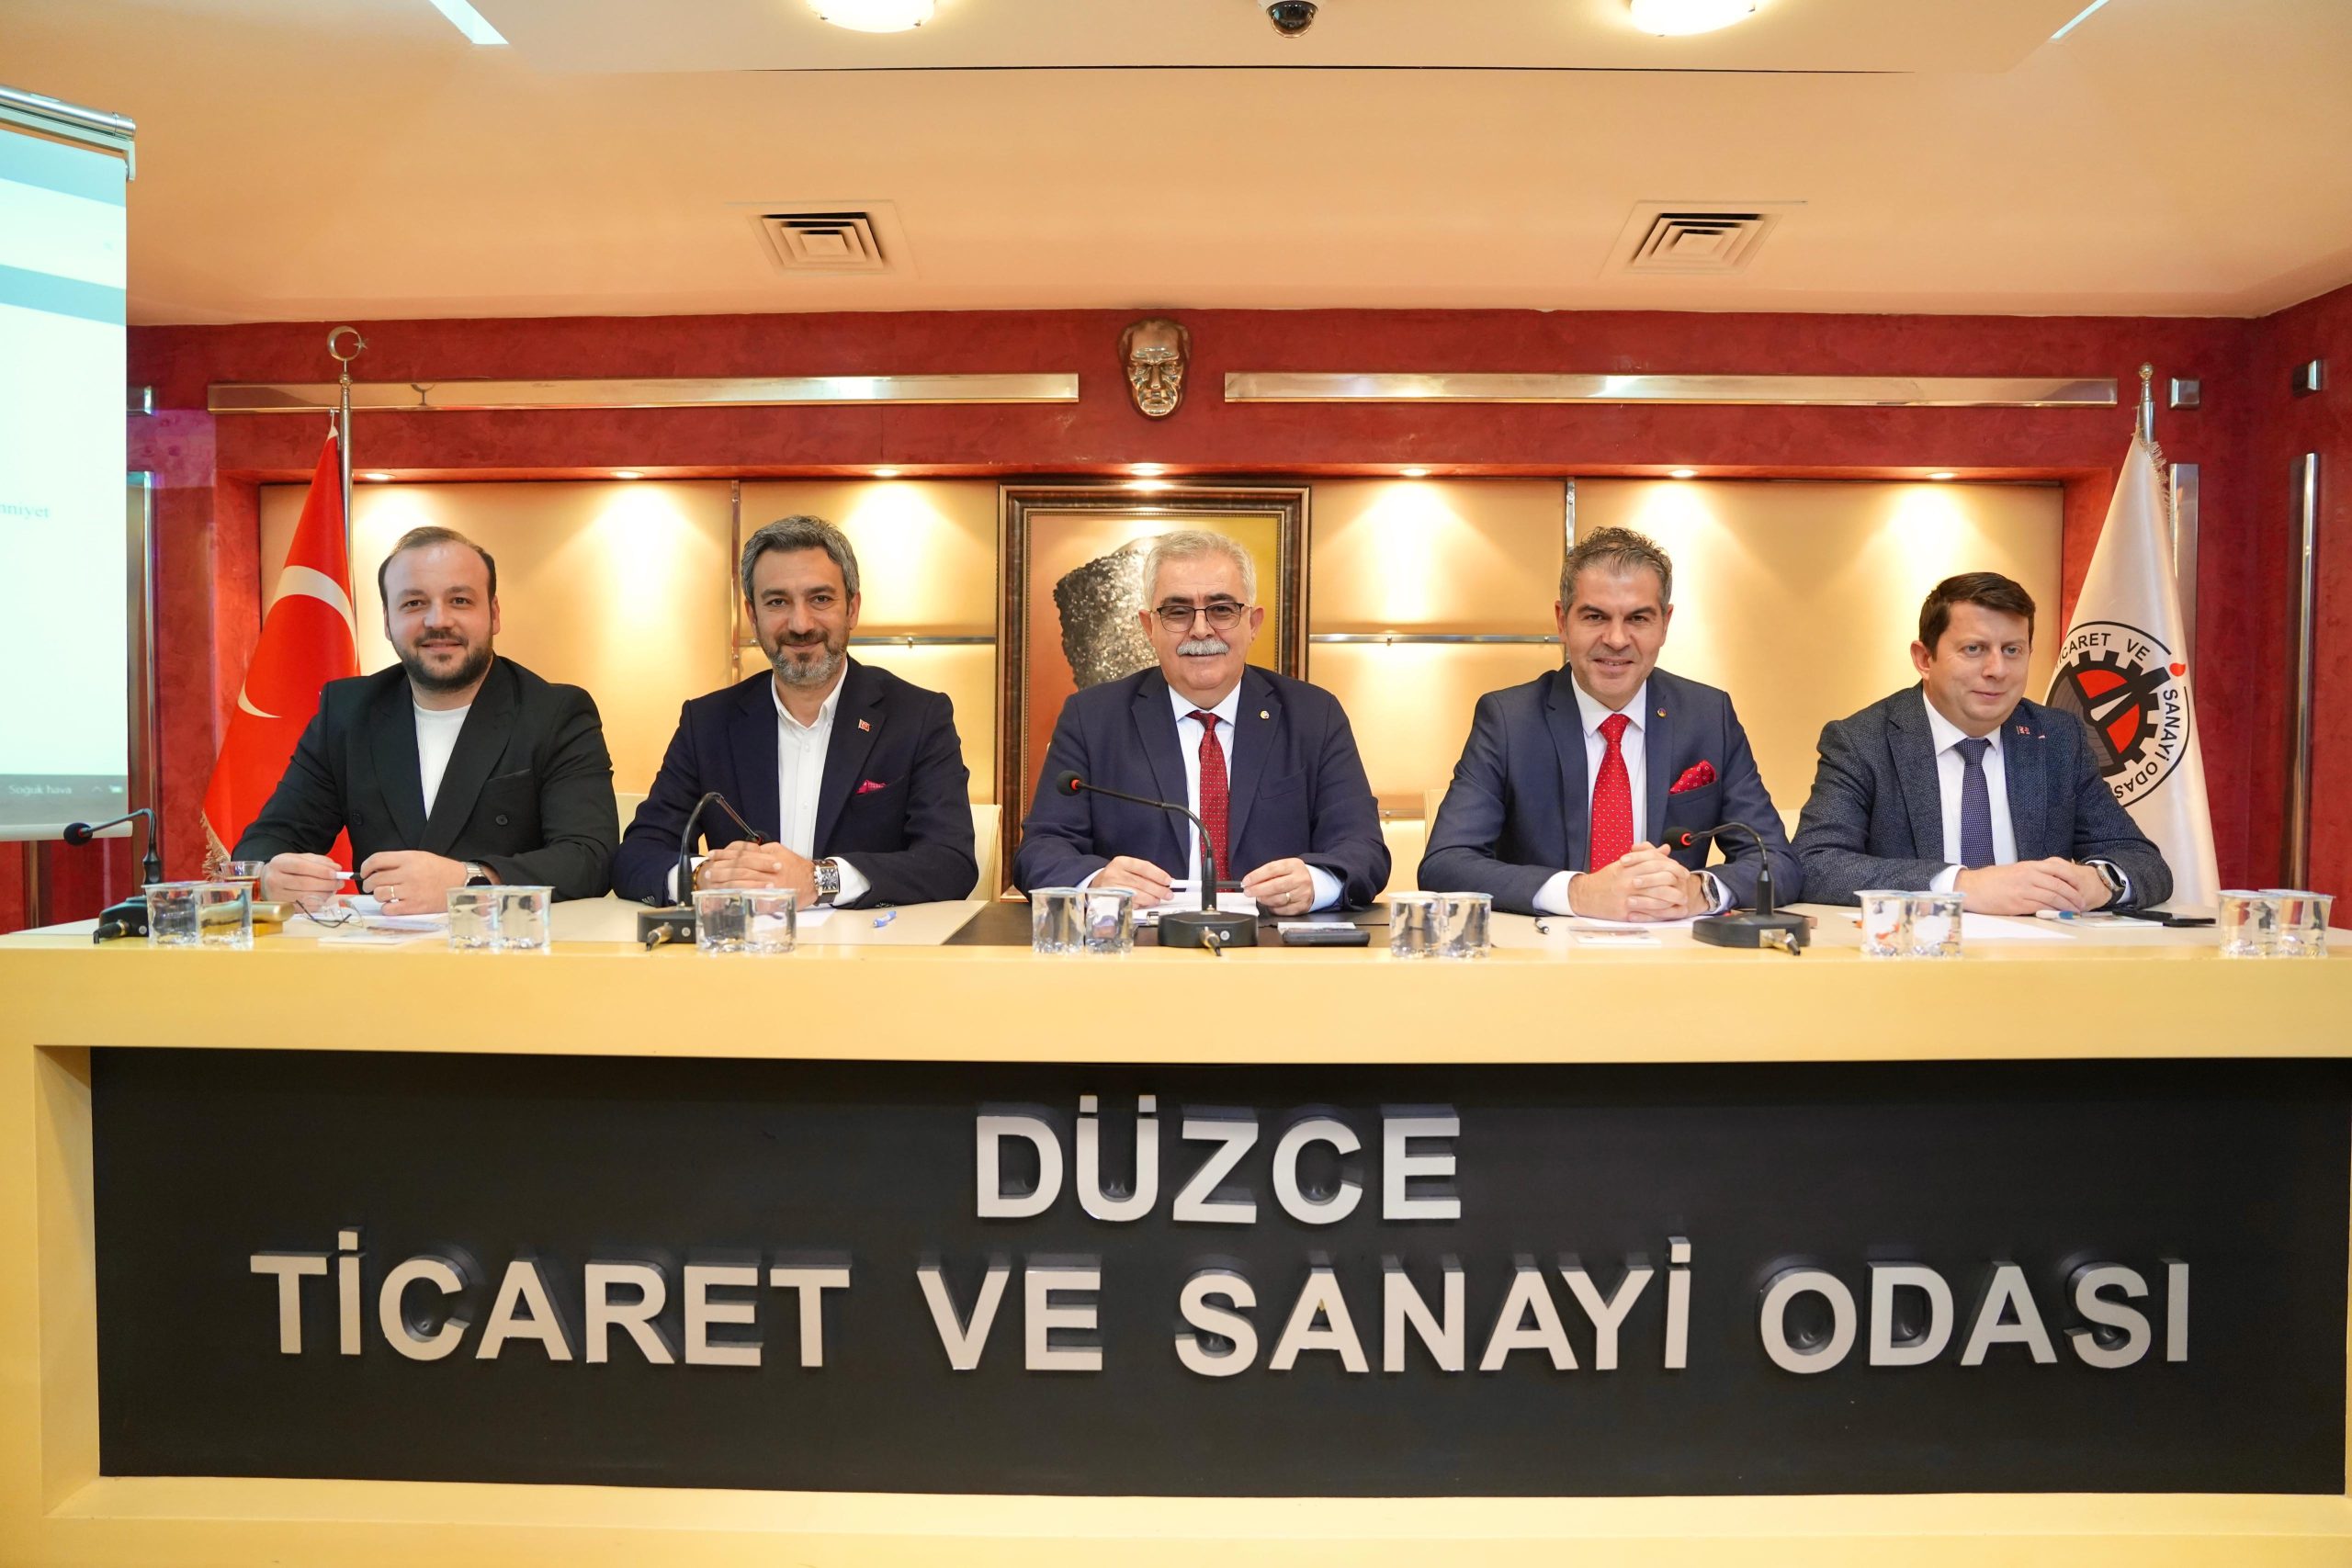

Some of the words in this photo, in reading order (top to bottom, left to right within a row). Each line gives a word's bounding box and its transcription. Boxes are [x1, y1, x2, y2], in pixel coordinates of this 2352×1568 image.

[2058, 633, 2111, 664] CARET
[2127, 638, 2151, 661] VE
[2154, 689, 2180, 761] SANAYİ
[2114, 762, 2158, 799] ODAS
[977, 1094, 1461, 1224] DÜZCE
[250, 1231, 850, 1367] TİCARET
[917, 1269, 1102, 1371] VE
[1175, 1243, 1690, 1376] SANAYİ
[1760, 1263, 2189, 1373] ODASI
